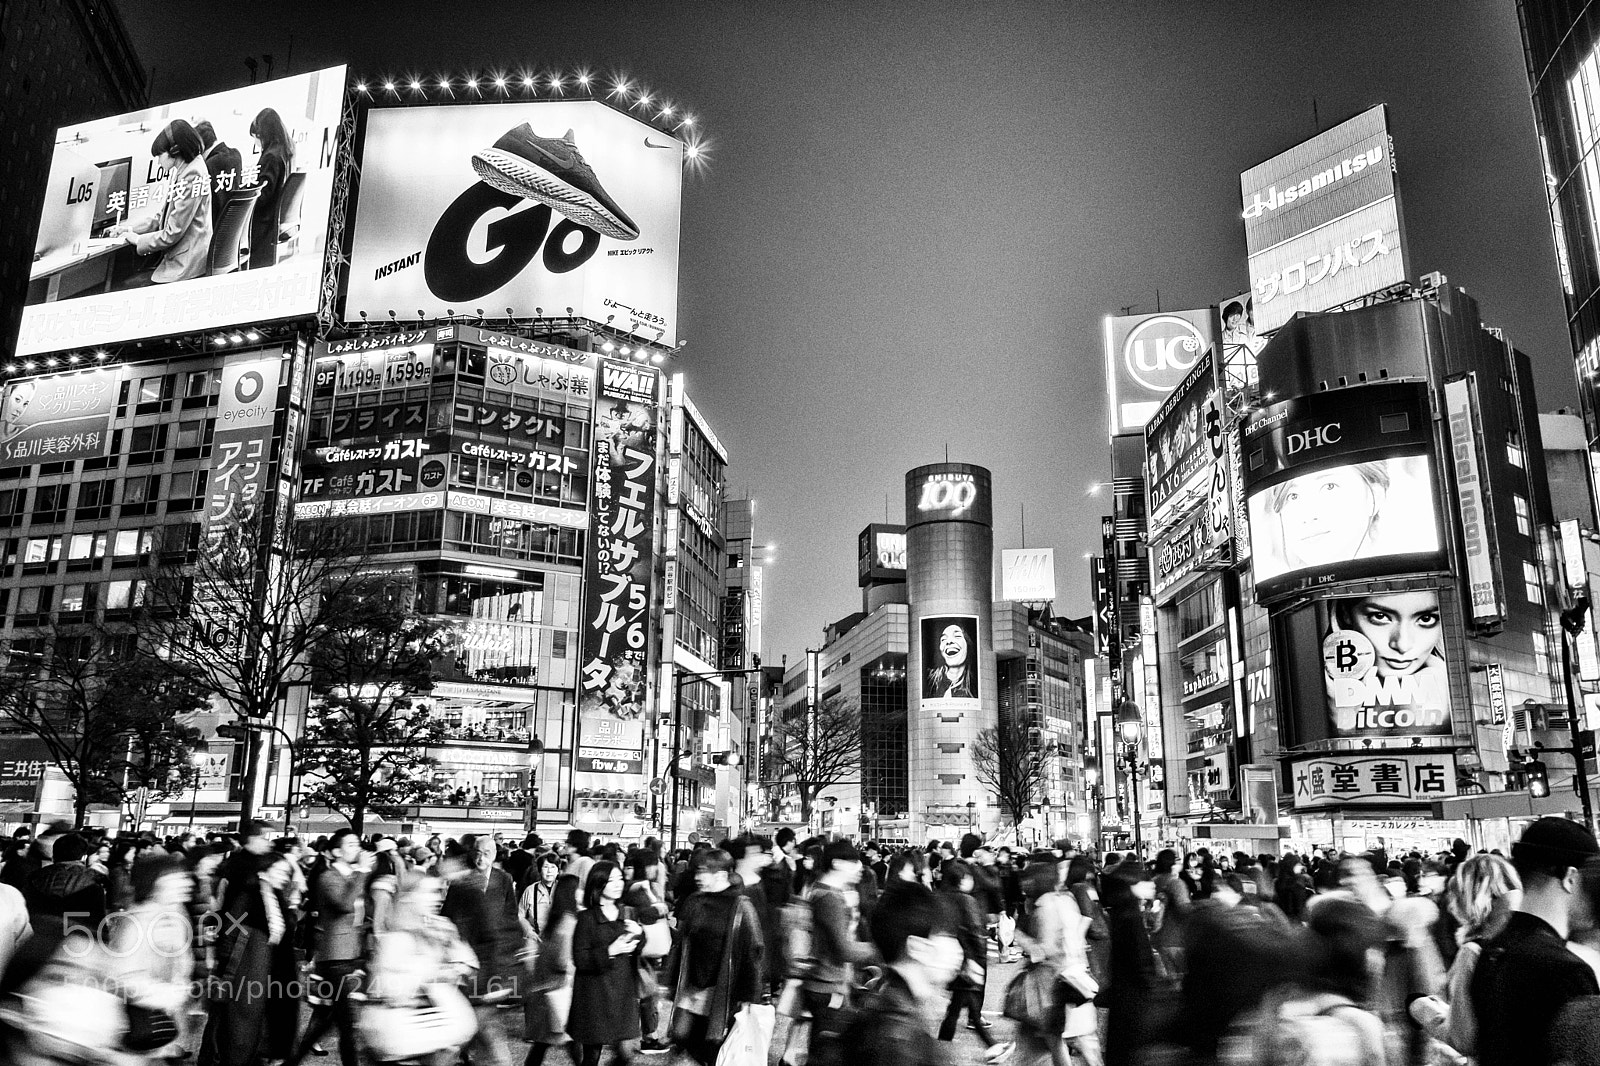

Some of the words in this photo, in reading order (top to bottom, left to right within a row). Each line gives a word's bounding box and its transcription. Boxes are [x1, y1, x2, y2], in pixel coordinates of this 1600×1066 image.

[66, 177, 93, 205] L05
[105, 164, 262, 214] 英語4技能対策
[1241, 145, 1384, 219] Hisamitsu
[374, 251, 422, 281] INSTANT
[1254, 228, 1390, 305] サロンパス
[327, 330, 428, 354] しゃぶしゃぶバイキング
[478, 330, 591, 364] しゃぶしゃぶバイキング
[53, 380, 110, 400] 品川スキン
[317, 371, 335, 385] 9F
[523, 364, 589, 395] しゃぶ葉
[603, 367, 655, 395] WA!!
[1165, 382, 1185, 417] DEBUT
[1185, 354, 1211, 391] SINGLE
[51, 396, 101, 415] クリニック
[223, 405, 268, 423] eyecity
[333, 404, 424, 434] プライス
[454, 402, 561, 439] コンタクト
[1245, 420, 1260, 437] DHC
[1258, 408, 1289, 430] Channel
[13, 431, 101, 459] 品川美容外科
[383, 438, 431, 461] ガスト
[1286, 422, 1342, 455] DHC
[528, 450, 578, 475] ガスト
[303, 477, 325, 494] 7F
[329, 474, 354, 488] Café
[355, 468, 413, 496] ガスト
[927, 474, 975, 483] SHIBUYA
[1151, 465, 1180, 512] DAY6
[452, 495, 486, 509] AEON
[917, 480, 977, 517] 109
[1460, 489, 1482, 557] neon
[1318, 573, 1336, 583] DHC
[1183, 669, 1219, 696] Euphoria
[598, 721, 626, 736] 品川
[591, 758, 629, 773] fbw.jp
[1297, 762, 1446, 798] 大盛堂書店
